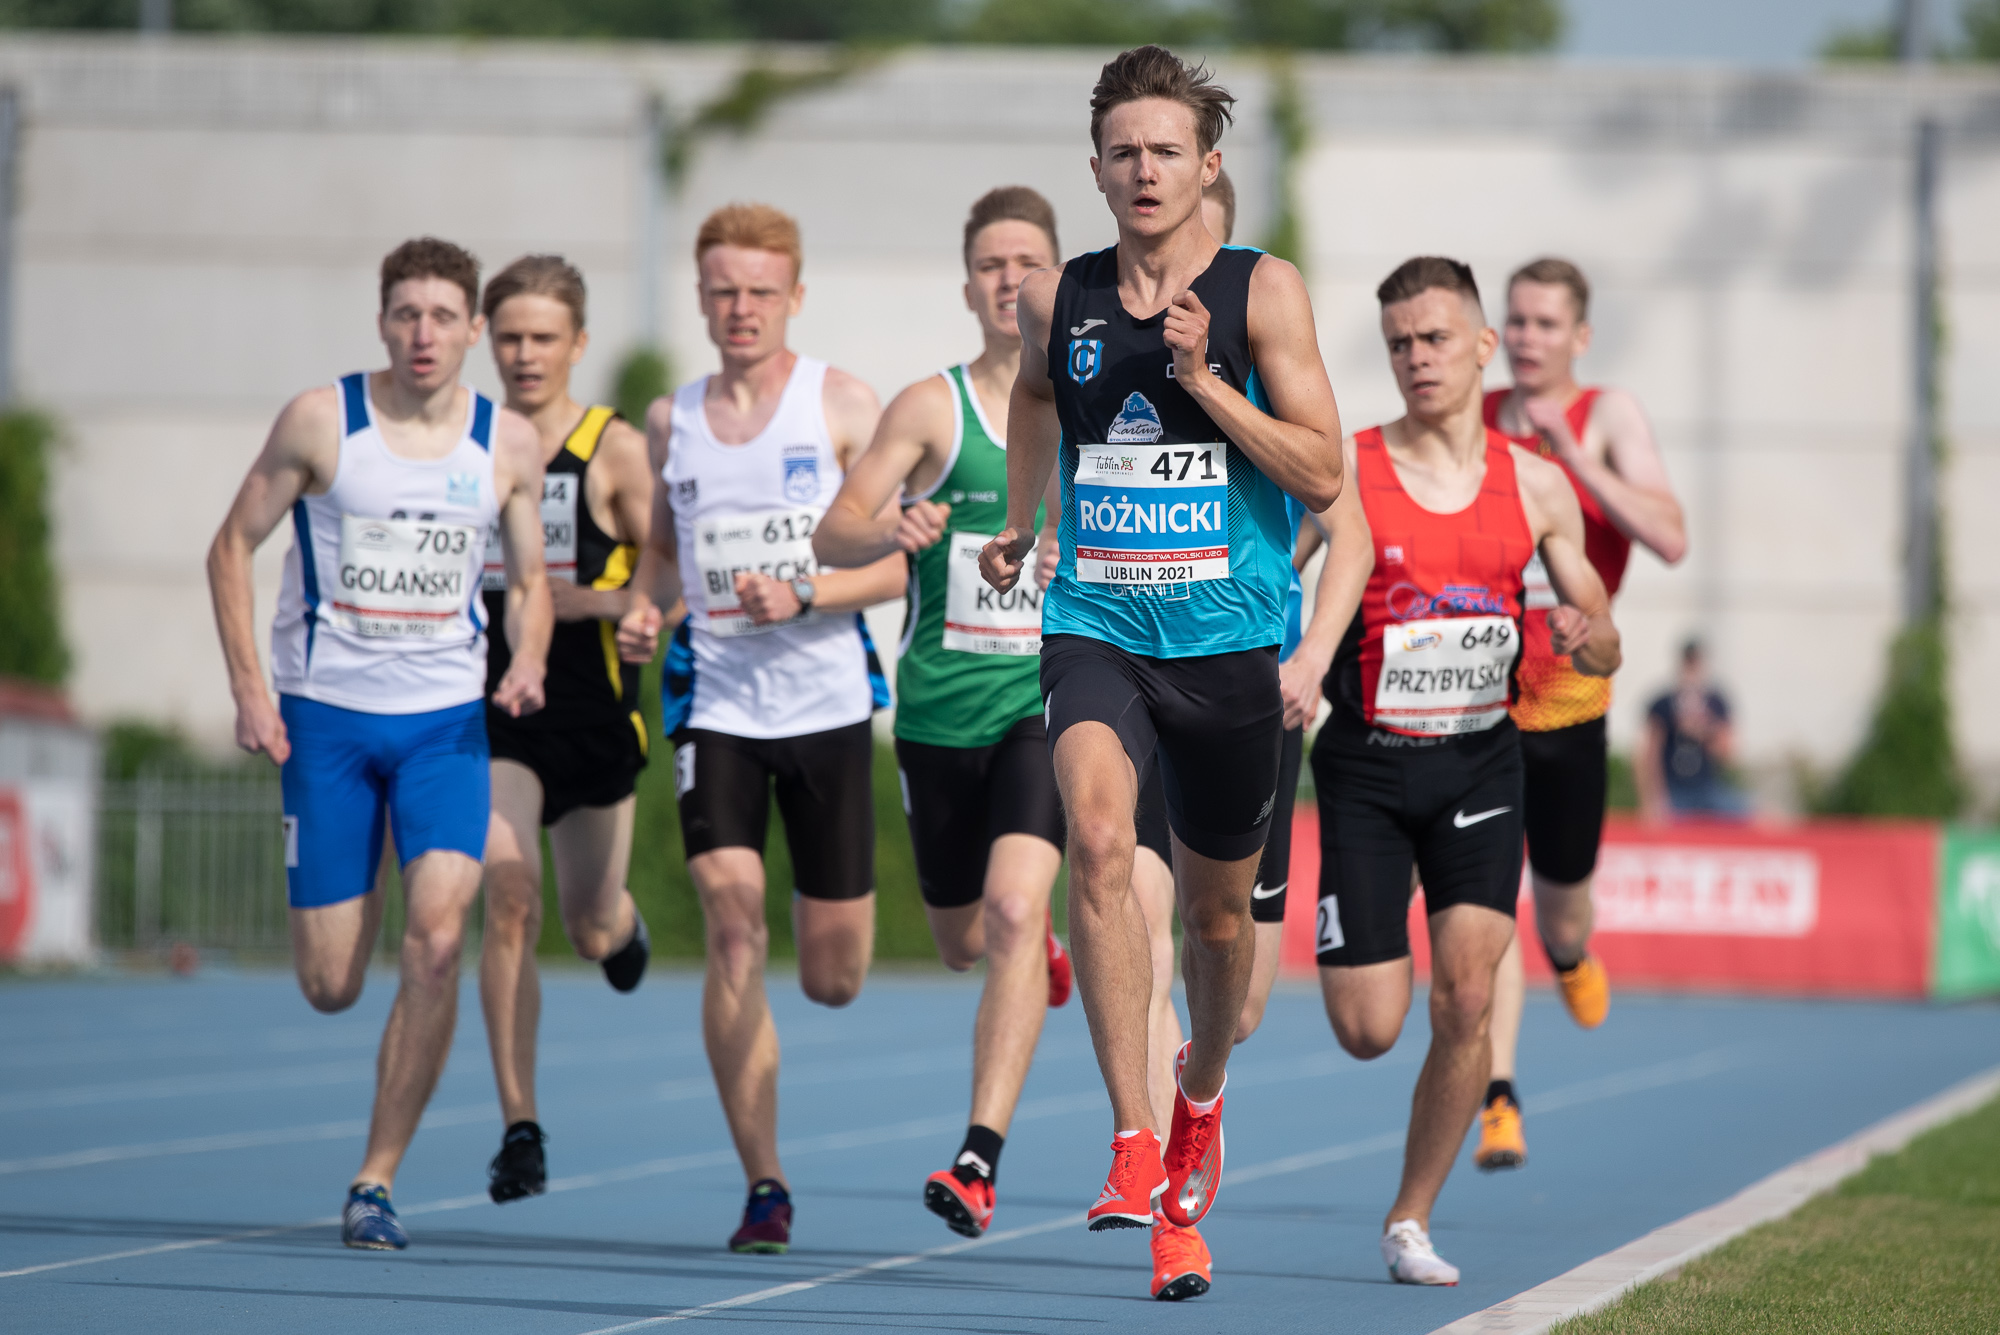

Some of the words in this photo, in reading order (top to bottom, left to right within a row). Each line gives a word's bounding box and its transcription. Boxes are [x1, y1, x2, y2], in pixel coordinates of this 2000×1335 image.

[1150, 450, 1218, 481] 471
[1080, 495, 1221, 534] RÓŻNICKI
[416, 527, 467, 554] 703
[763, 515, 813, 543] 612
[1094, 552, 1111, 560] PZLA
[1173, 551, 1203, 560] POLSKI
[1204, 550, 1222, 558] U20
[341, 565, 461, 596] GOLAŃSKI
[1104, 566, 1152, 581] LUBLIN
[1157, 566, 1193, 580] 2021
[1461, 624, 1511, 650] 649
[1386, 664, 1505, 693] PRZYBYLSKI
[1318, 905, 1332, 947] 2
